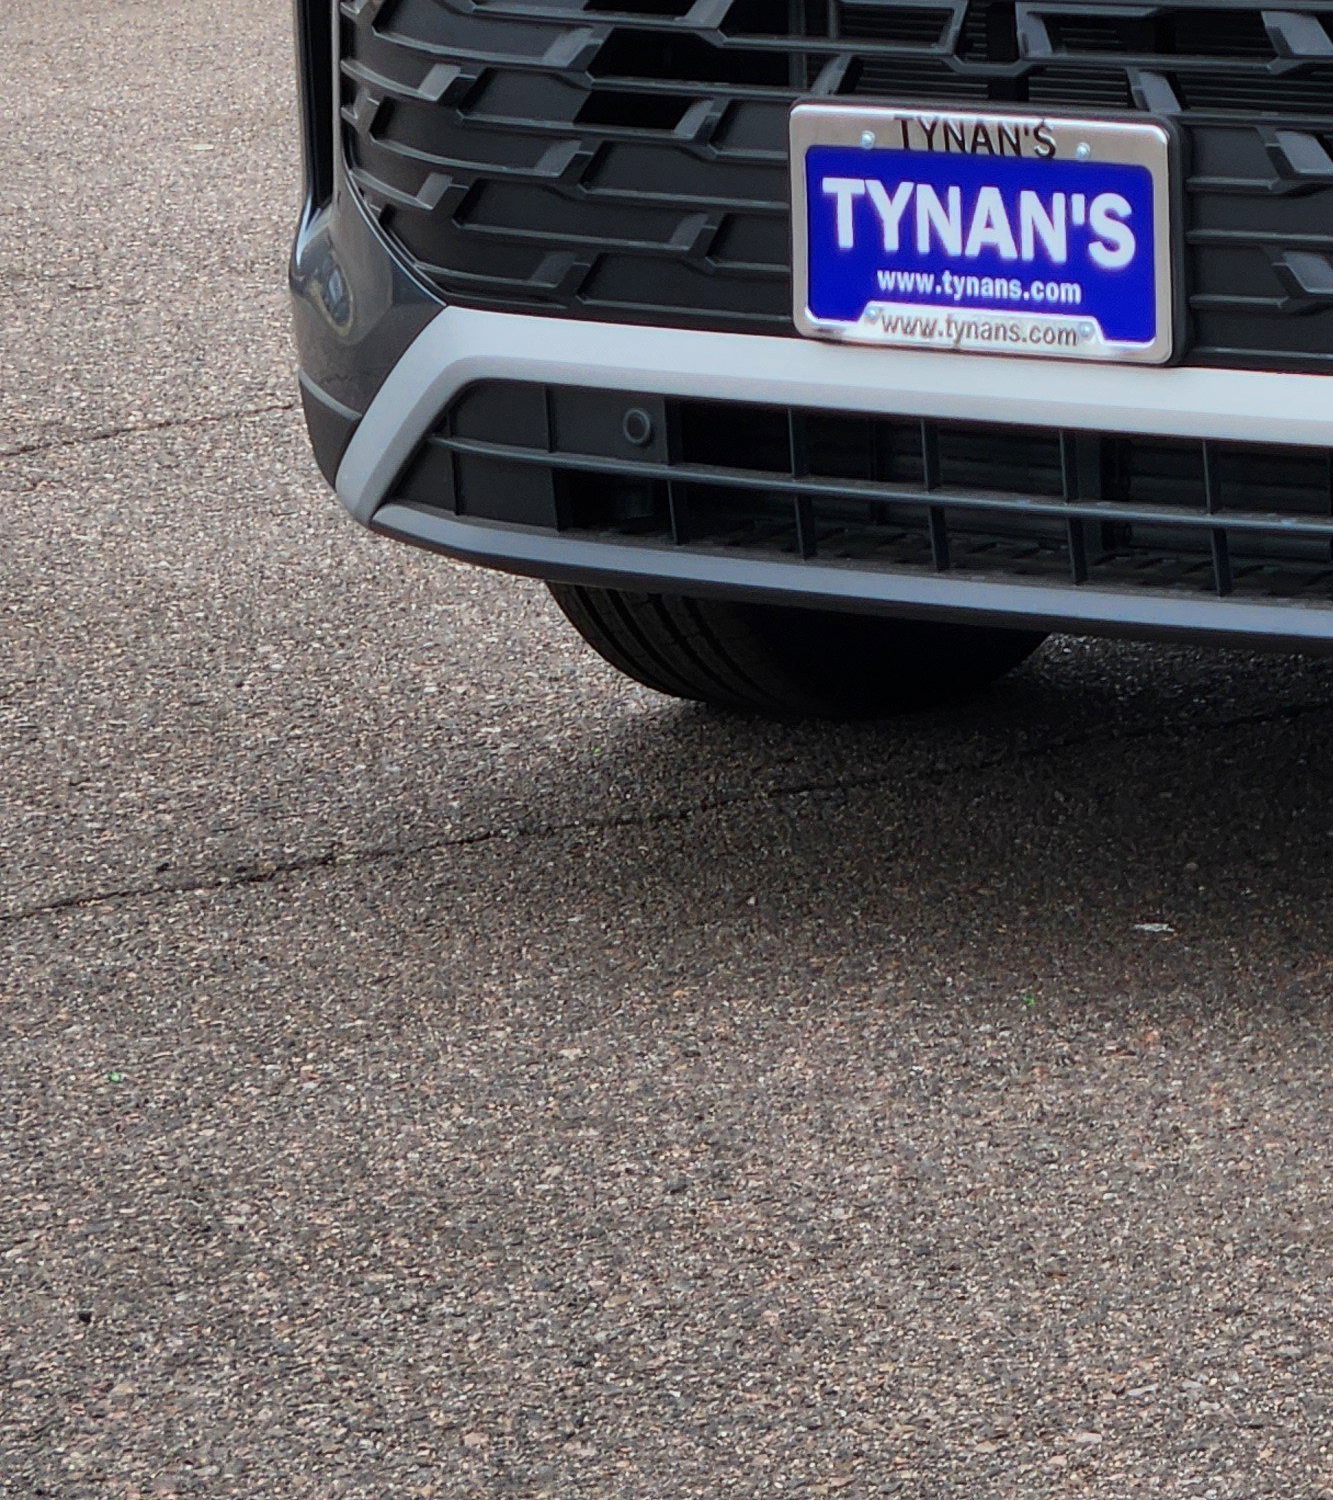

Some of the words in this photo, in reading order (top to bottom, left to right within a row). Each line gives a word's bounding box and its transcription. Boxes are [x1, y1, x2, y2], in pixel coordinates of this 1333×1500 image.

[894, 114, 1057, 159] TYNAN'S
[822, 177, 1136, 268] TYNAN'S
[877, 269, 1082, 304] www.tynans.com
[880, 312, 1079, 347] www.tynans.com
